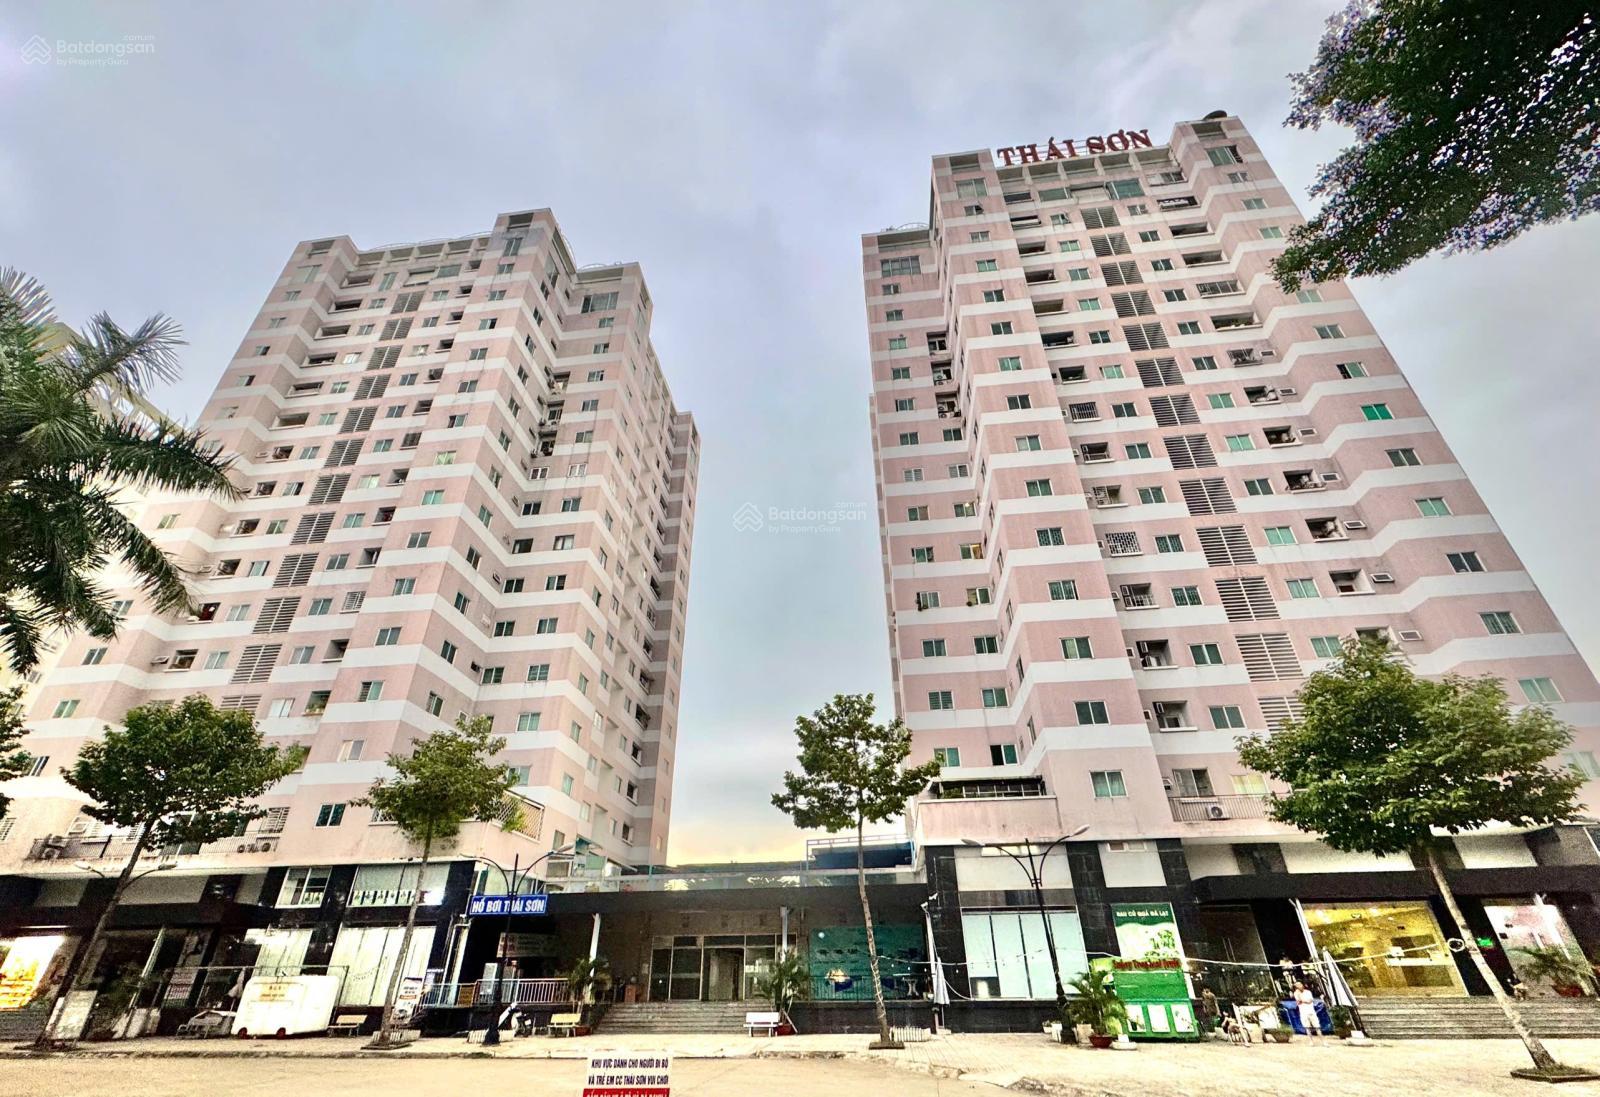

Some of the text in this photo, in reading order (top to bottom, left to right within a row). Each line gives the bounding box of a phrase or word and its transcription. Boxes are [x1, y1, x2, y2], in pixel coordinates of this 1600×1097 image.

[996, 129, 1153, 166] THÁI SƠN
[486, 899, 502, 912] BƠI
[525, 899, 544, 912] SƠN
[591, 1059, 602, 1068] KHU
[628, 1059, 639, 1068] CHO
[606, 1075, 614, 1085] EM
[615, 1075, 623, 1085] CC
[624, 1074, 635, 1085] THÁI
[636, 1075, 647, 1085] SƠN
